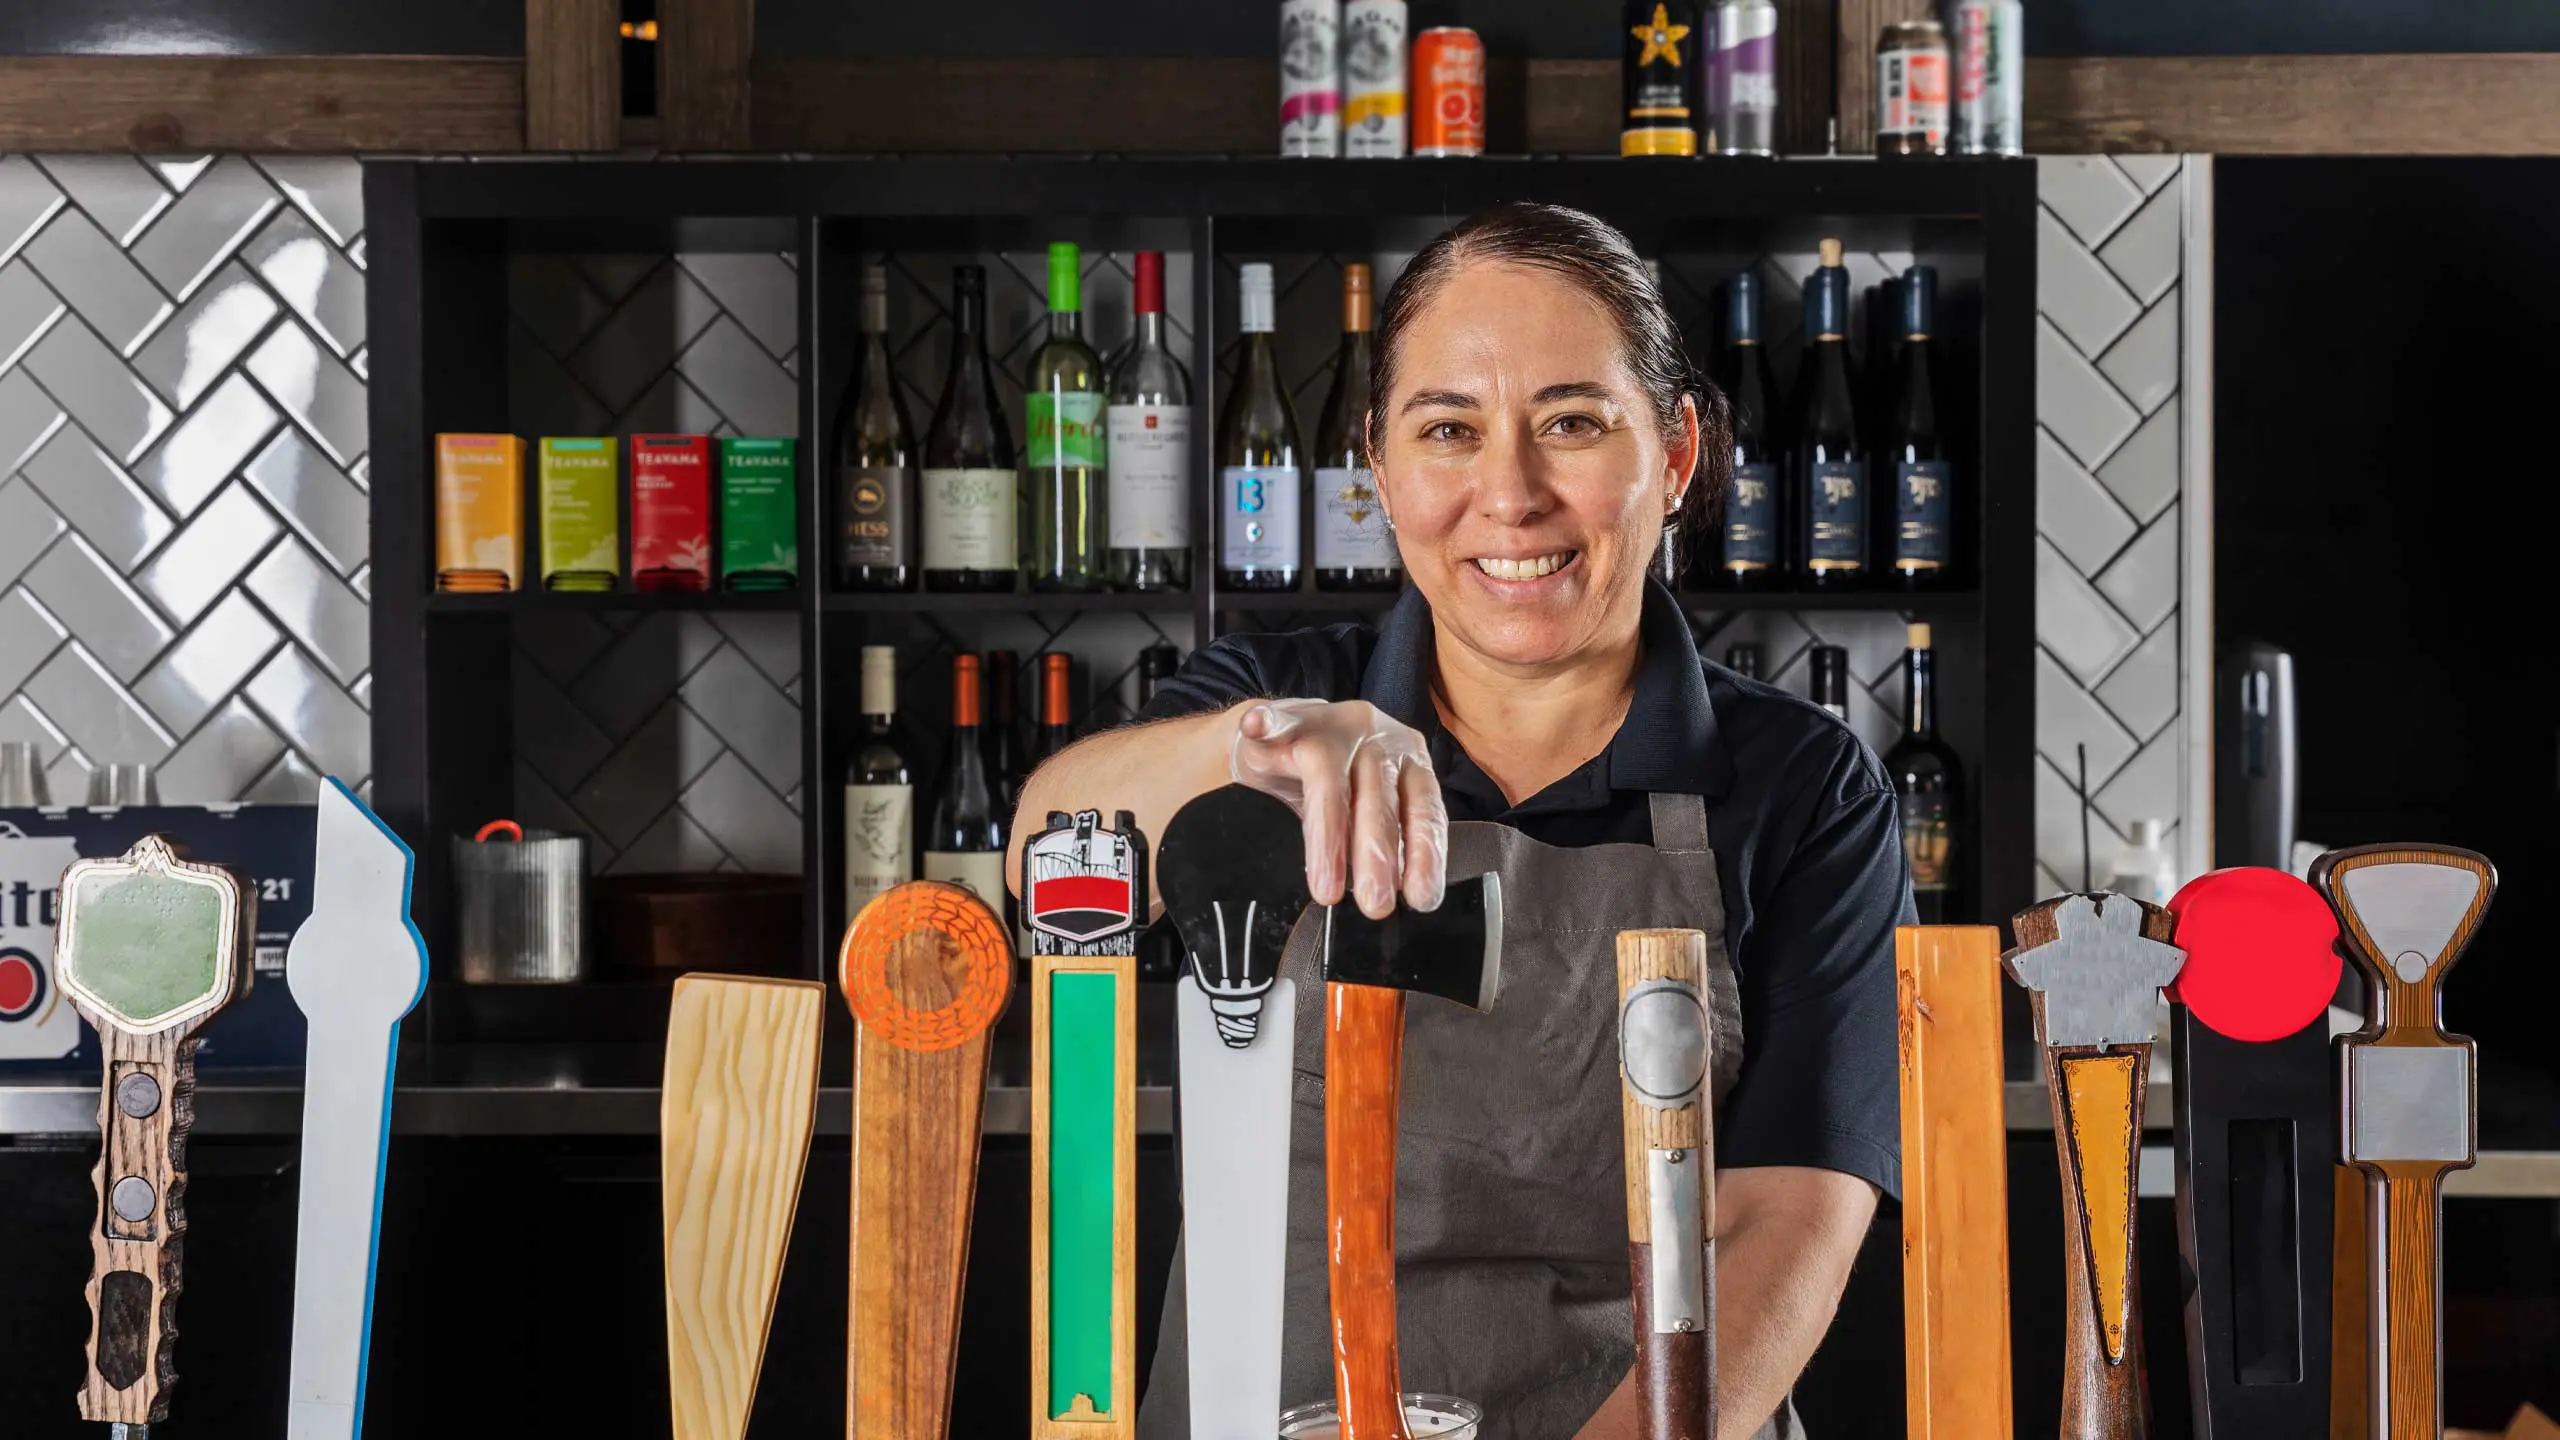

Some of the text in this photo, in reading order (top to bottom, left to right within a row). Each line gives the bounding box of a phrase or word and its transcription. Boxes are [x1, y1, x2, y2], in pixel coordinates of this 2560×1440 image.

[547, 455, 610, 468] TEAVANA
[637, 452, 700, 465] TEAVANA
[728, 454, 790, 467] TEAVANA
[262, 878, 291, 901] 21
[0, 880, 58, 928] te
